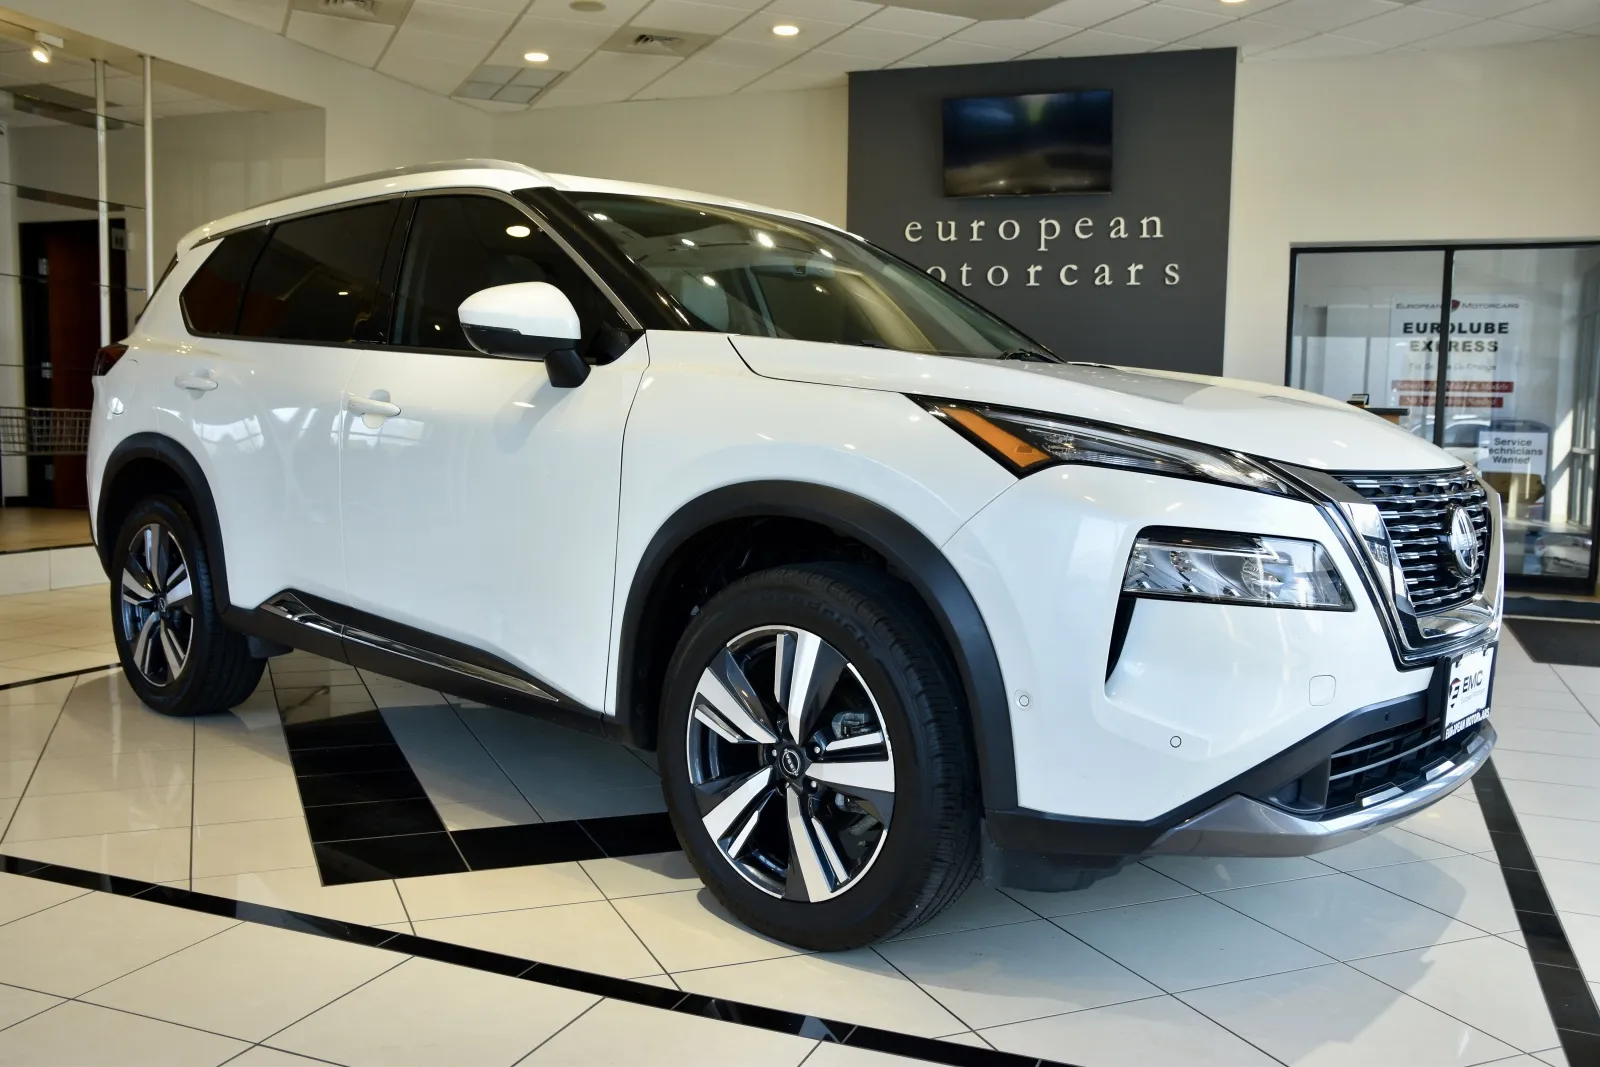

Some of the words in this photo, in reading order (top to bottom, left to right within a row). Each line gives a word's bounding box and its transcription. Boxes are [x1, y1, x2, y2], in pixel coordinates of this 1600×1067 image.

[904, 214, 1164, 251] european
[926, 262, 1181, 287] otorcars
[1462, 302, 1520, 310] MOTORCARS
[1410, 341, 1499, 352] EXRESS
[1494, 437, 1533, 447] Service
[1488, 447, 1544, 456] echnicians
[1492, 455, 1531, 464] Wanted
[1462, 670, 1483, 693] EMC
